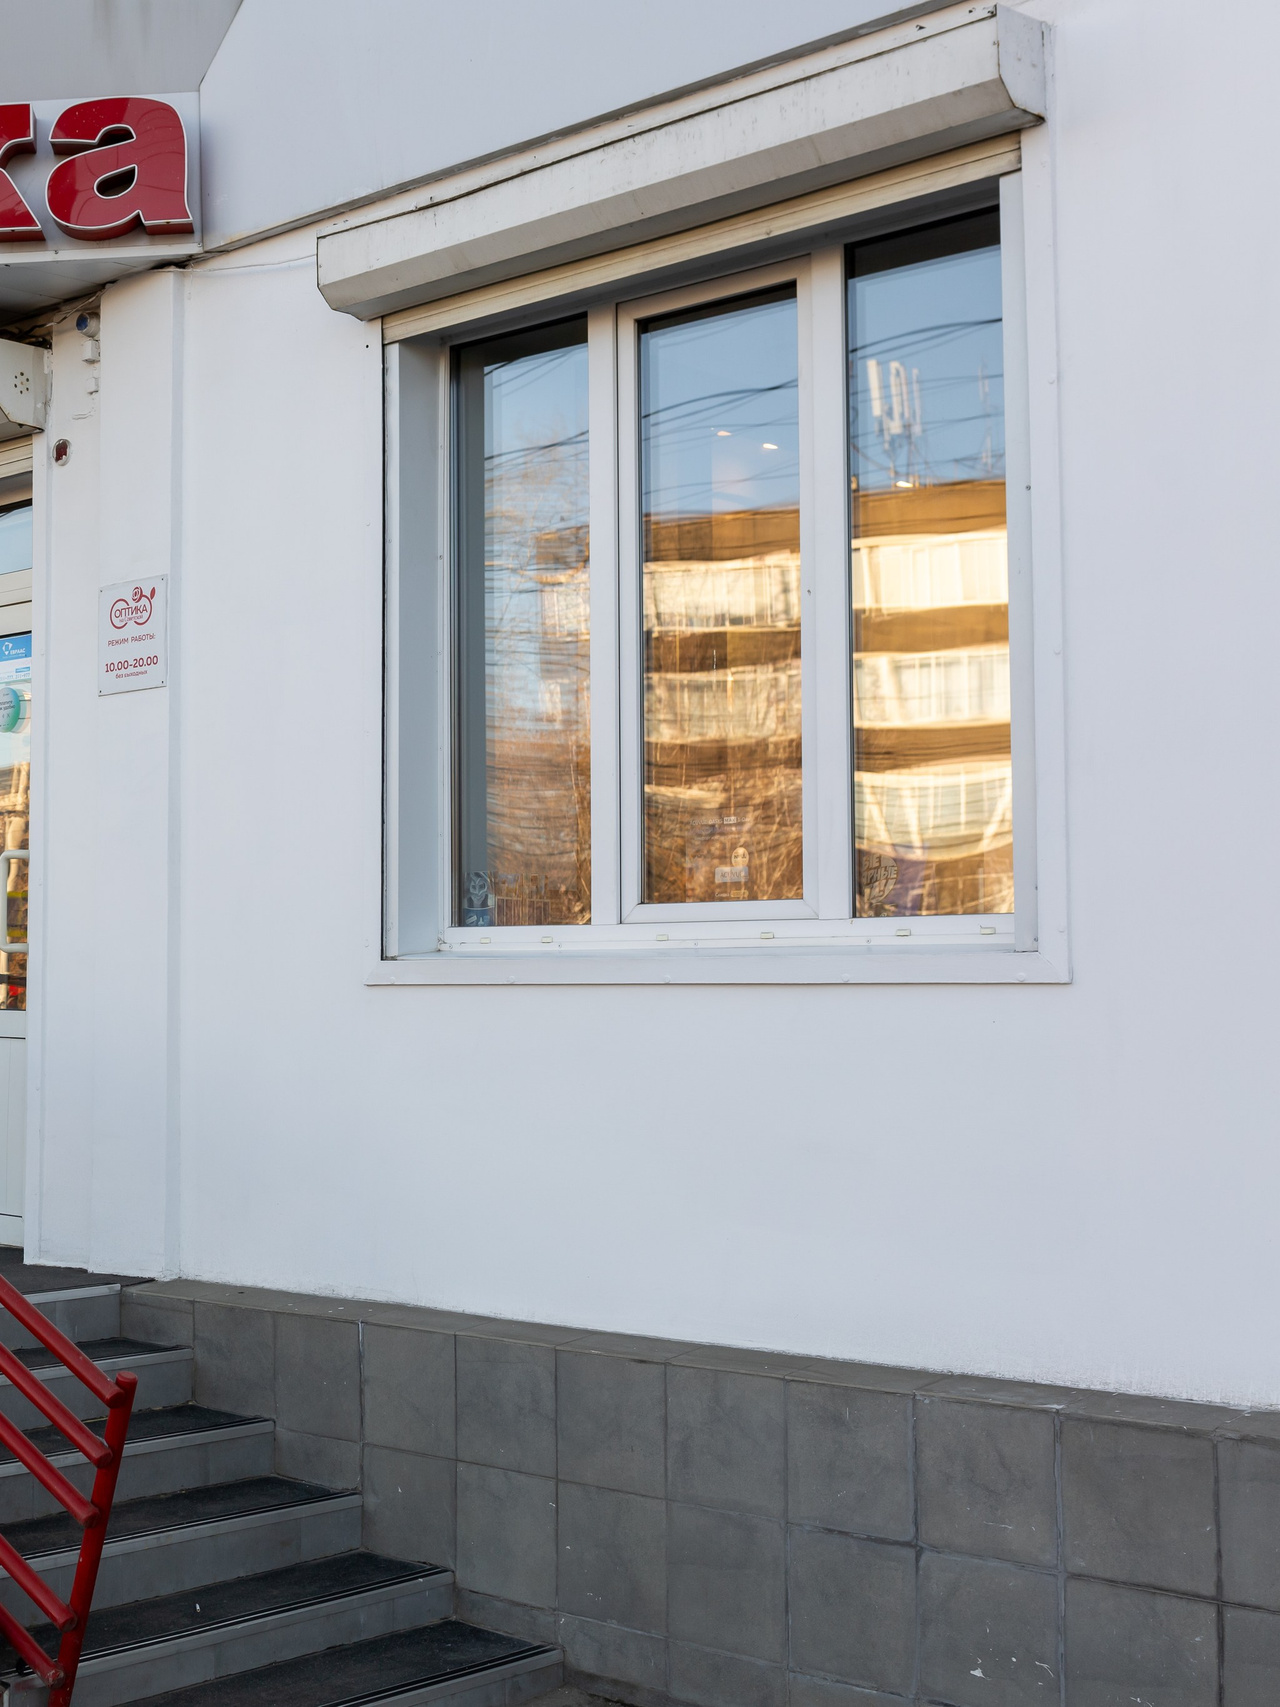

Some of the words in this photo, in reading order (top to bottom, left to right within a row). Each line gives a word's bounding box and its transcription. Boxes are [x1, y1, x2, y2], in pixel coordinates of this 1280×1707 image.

[114, 604, 148, 619] ОПТИКА
[108, 637, 129, 647] РЕЖИМ
[105, 655, 159, 673] 10.00-20.00
